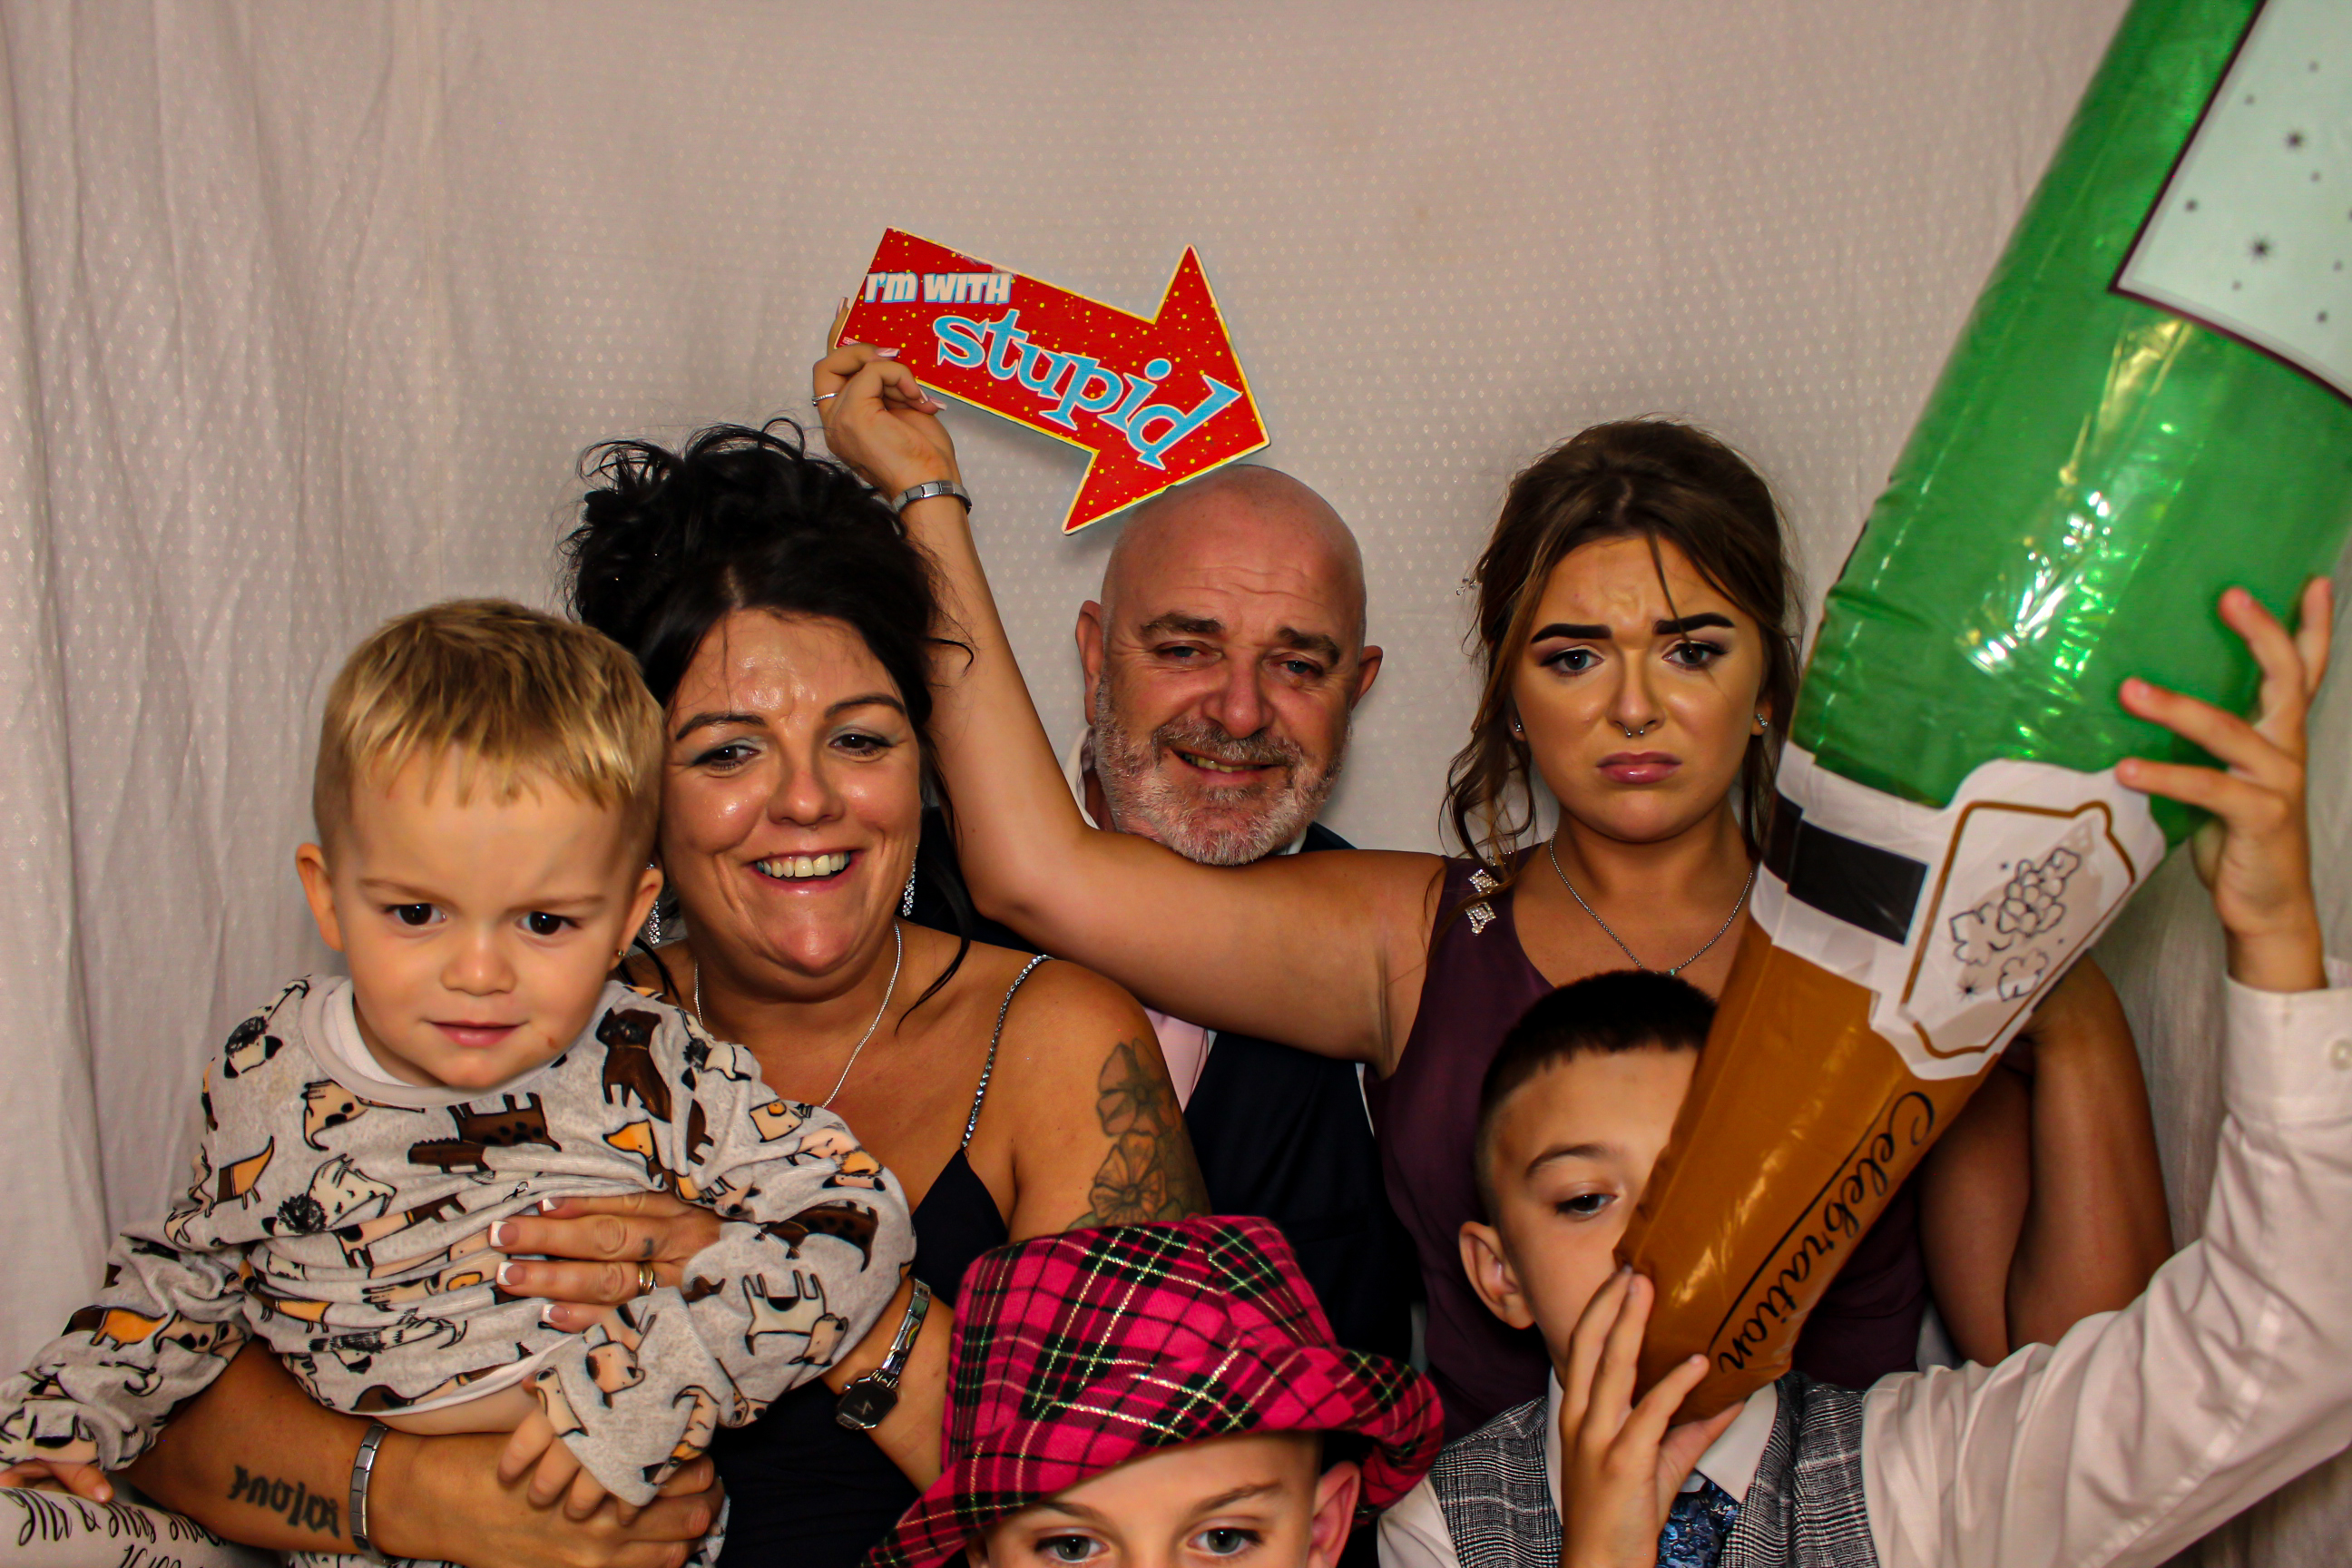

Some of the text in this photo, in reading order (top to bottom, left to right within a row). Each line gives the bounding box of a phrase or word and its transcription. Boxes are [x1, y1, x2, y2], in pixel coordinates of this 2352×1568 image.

[923, 272, 1014, 304] WITH
[933, 309, 1243, 470] stupid
[1718, 1091, 1936, 1374] Celebration
